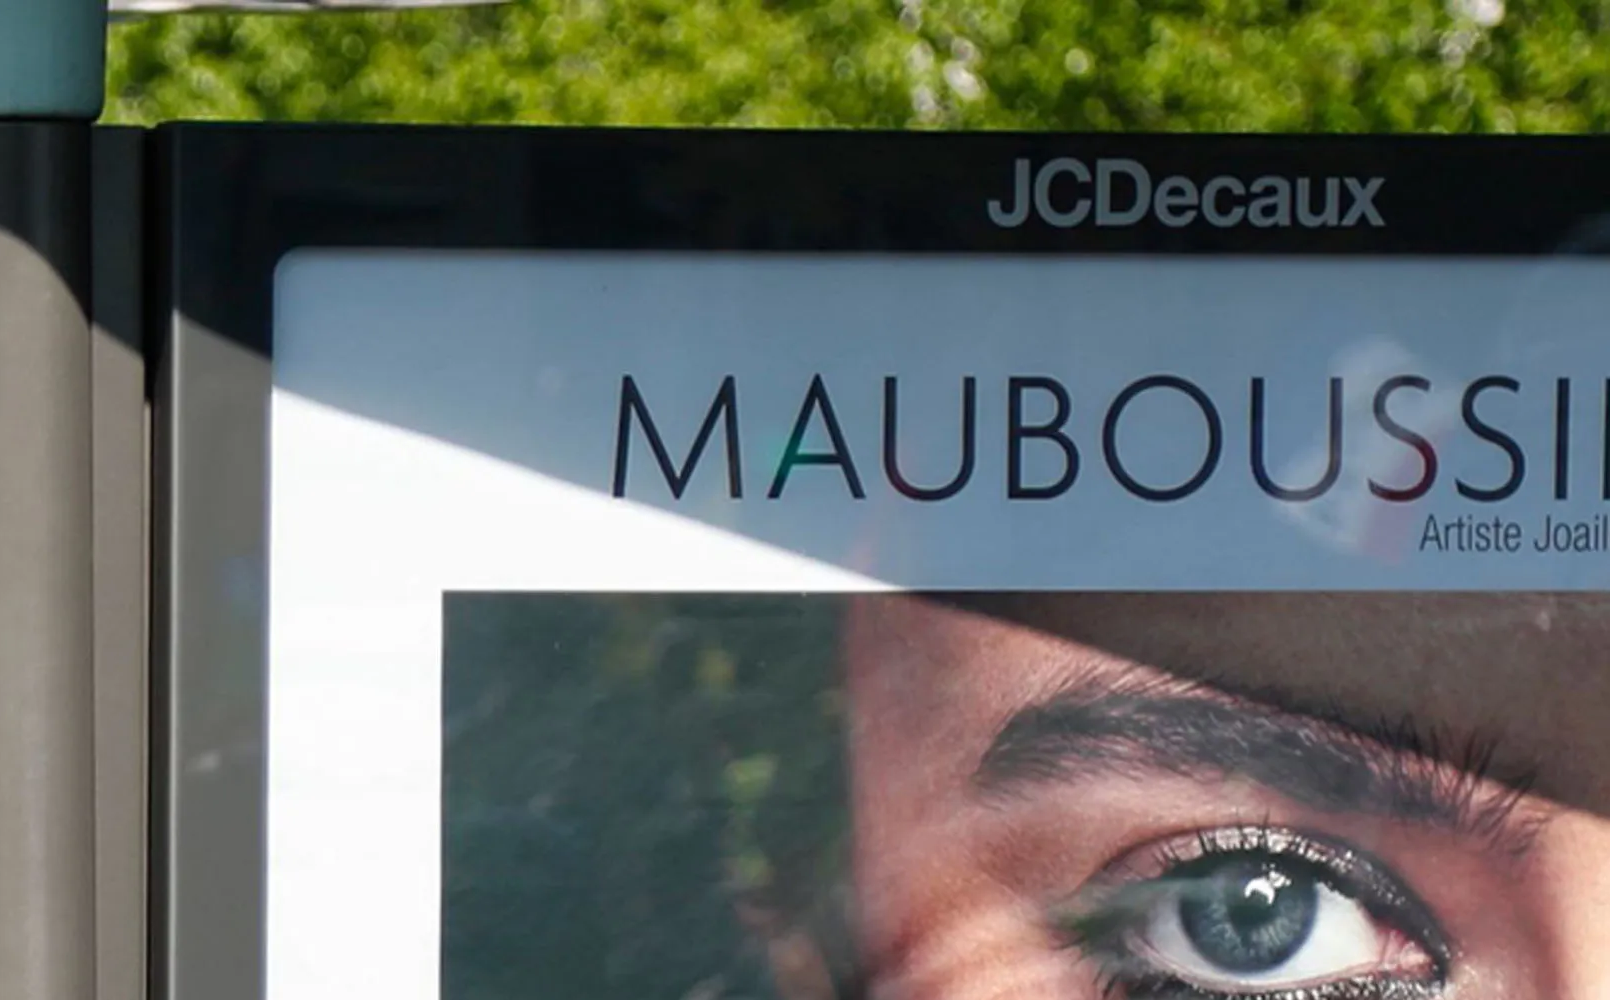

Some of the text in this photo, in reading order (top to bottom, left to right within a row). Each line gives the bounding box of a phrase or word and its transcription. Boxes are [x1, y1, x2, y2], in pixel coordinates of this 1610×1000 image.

[987, 157, 1387, 229] JCDecaux
[612, 374, 1610, 502] MAUBOUSSI
[1419, 513, 1522, 552] Artiste
